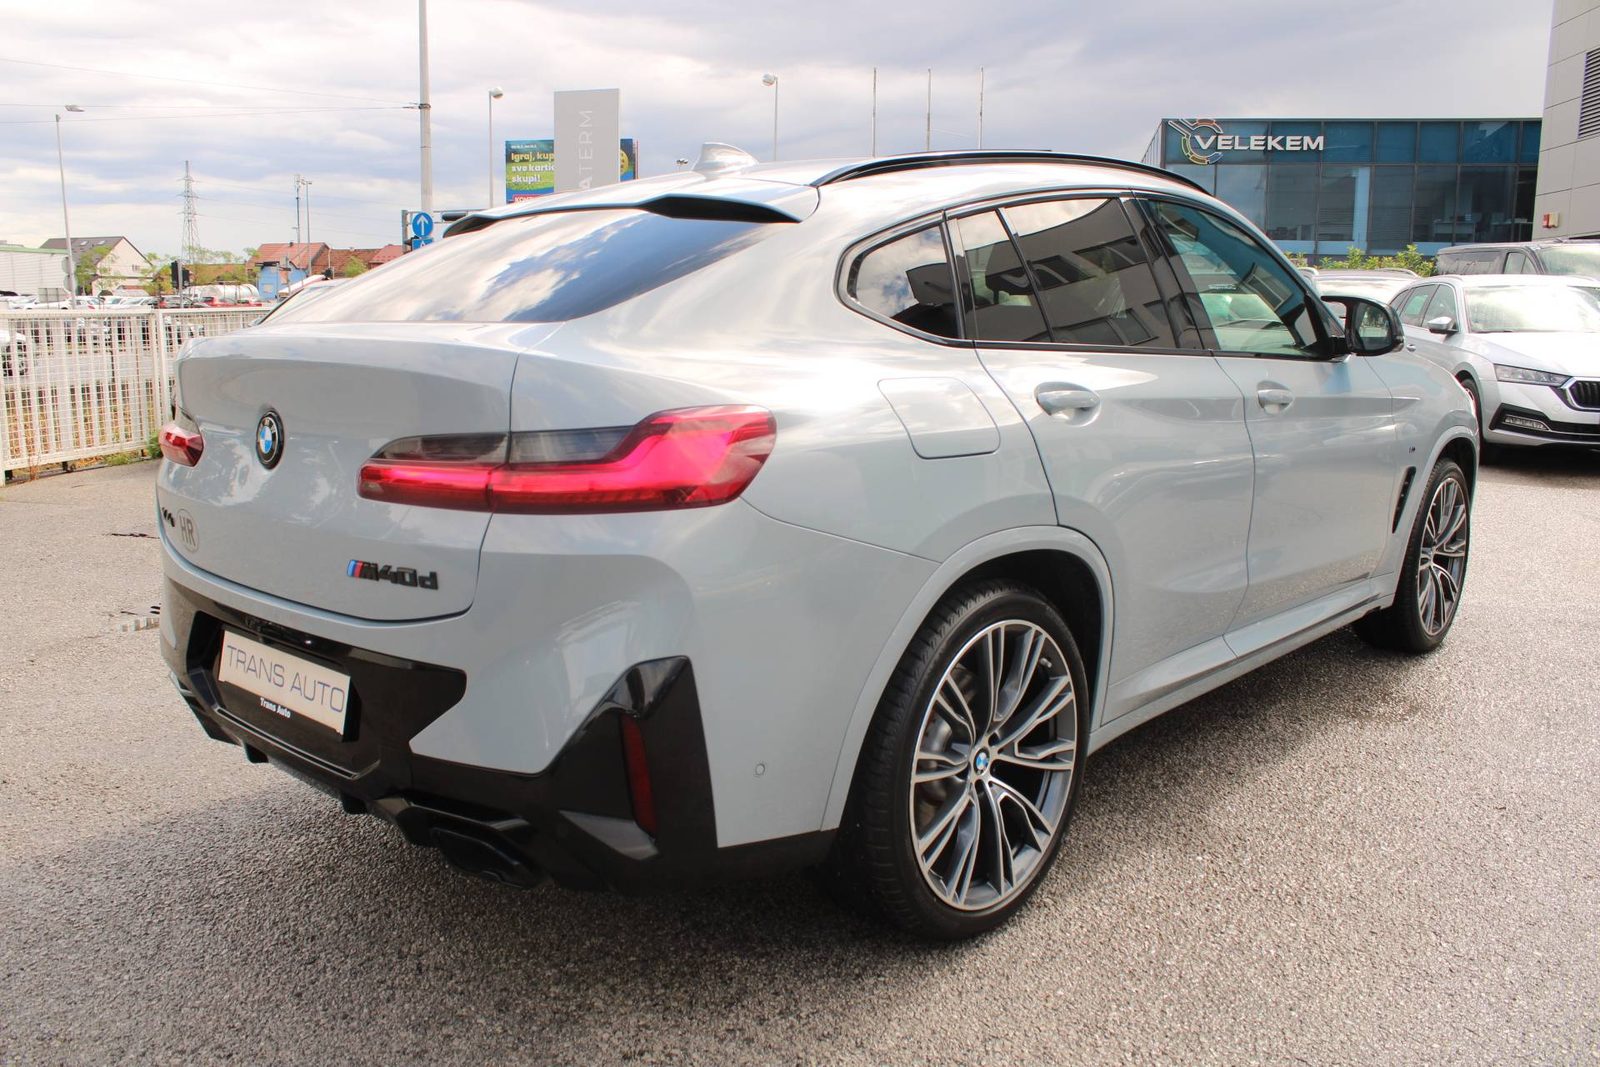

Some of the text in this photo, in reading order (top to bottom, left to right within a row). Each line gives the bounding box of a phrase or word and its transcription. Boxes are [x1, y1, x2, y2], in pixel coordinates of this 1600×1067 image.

[1195, 135, 1324, 151] VELEKEM
[511, 152, 535, 162] Igraj,
[512, 174, 541, 184] skupi!
[179, 514, 196, 547] HR
[358, 560, 439, 590] M40d
[226, 645, 345, 713] TRANS AUTO
[260, 697, 291, 718] Trans Auto
